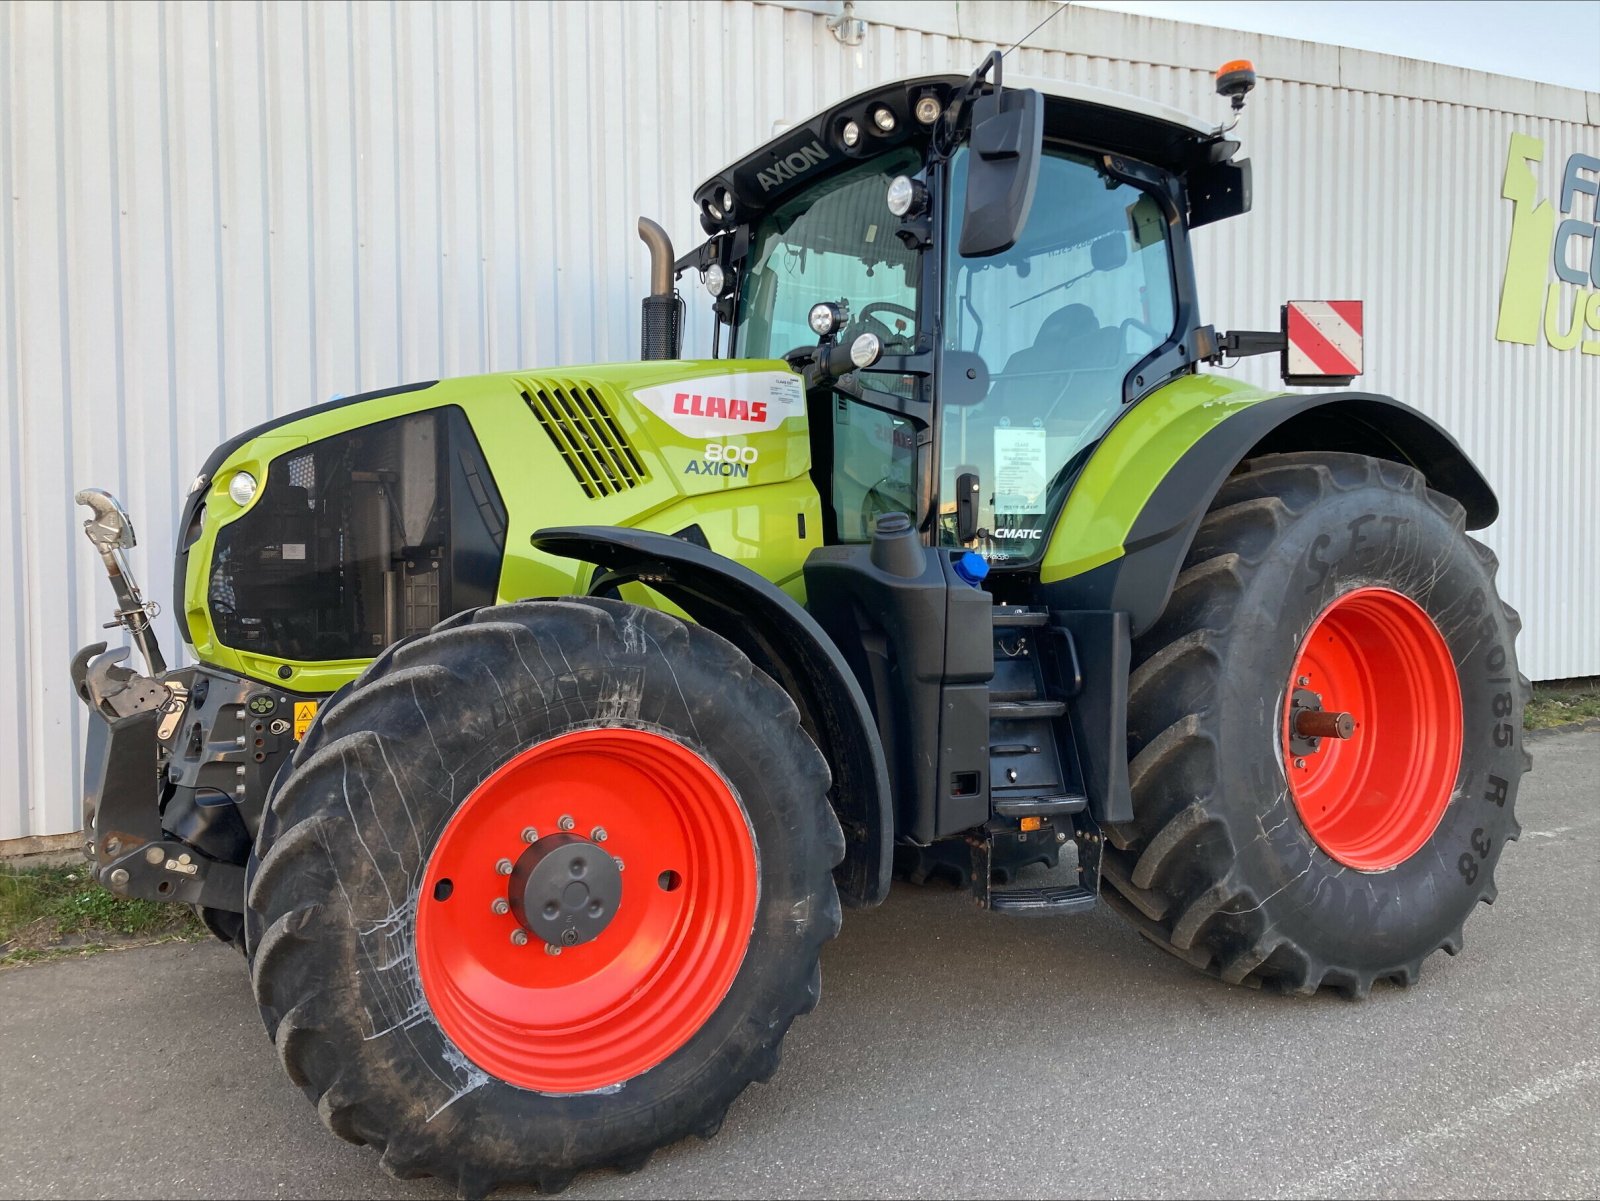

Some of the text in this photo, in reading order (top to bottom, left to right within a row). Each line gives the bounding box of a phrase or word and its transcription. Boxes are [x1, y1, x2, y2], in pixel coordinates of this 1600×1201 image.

[756, 140, 829, 192] AXION
[673, 393, 767, 423] CLAAS
[704, 443, 758, 464] 800
[684, 460, 749, 478] AXION
[994, 528, 1042, 539] CMATIC
[1484, 774, 1509, 809] R
[1457, 827, 1491, 886] 38
